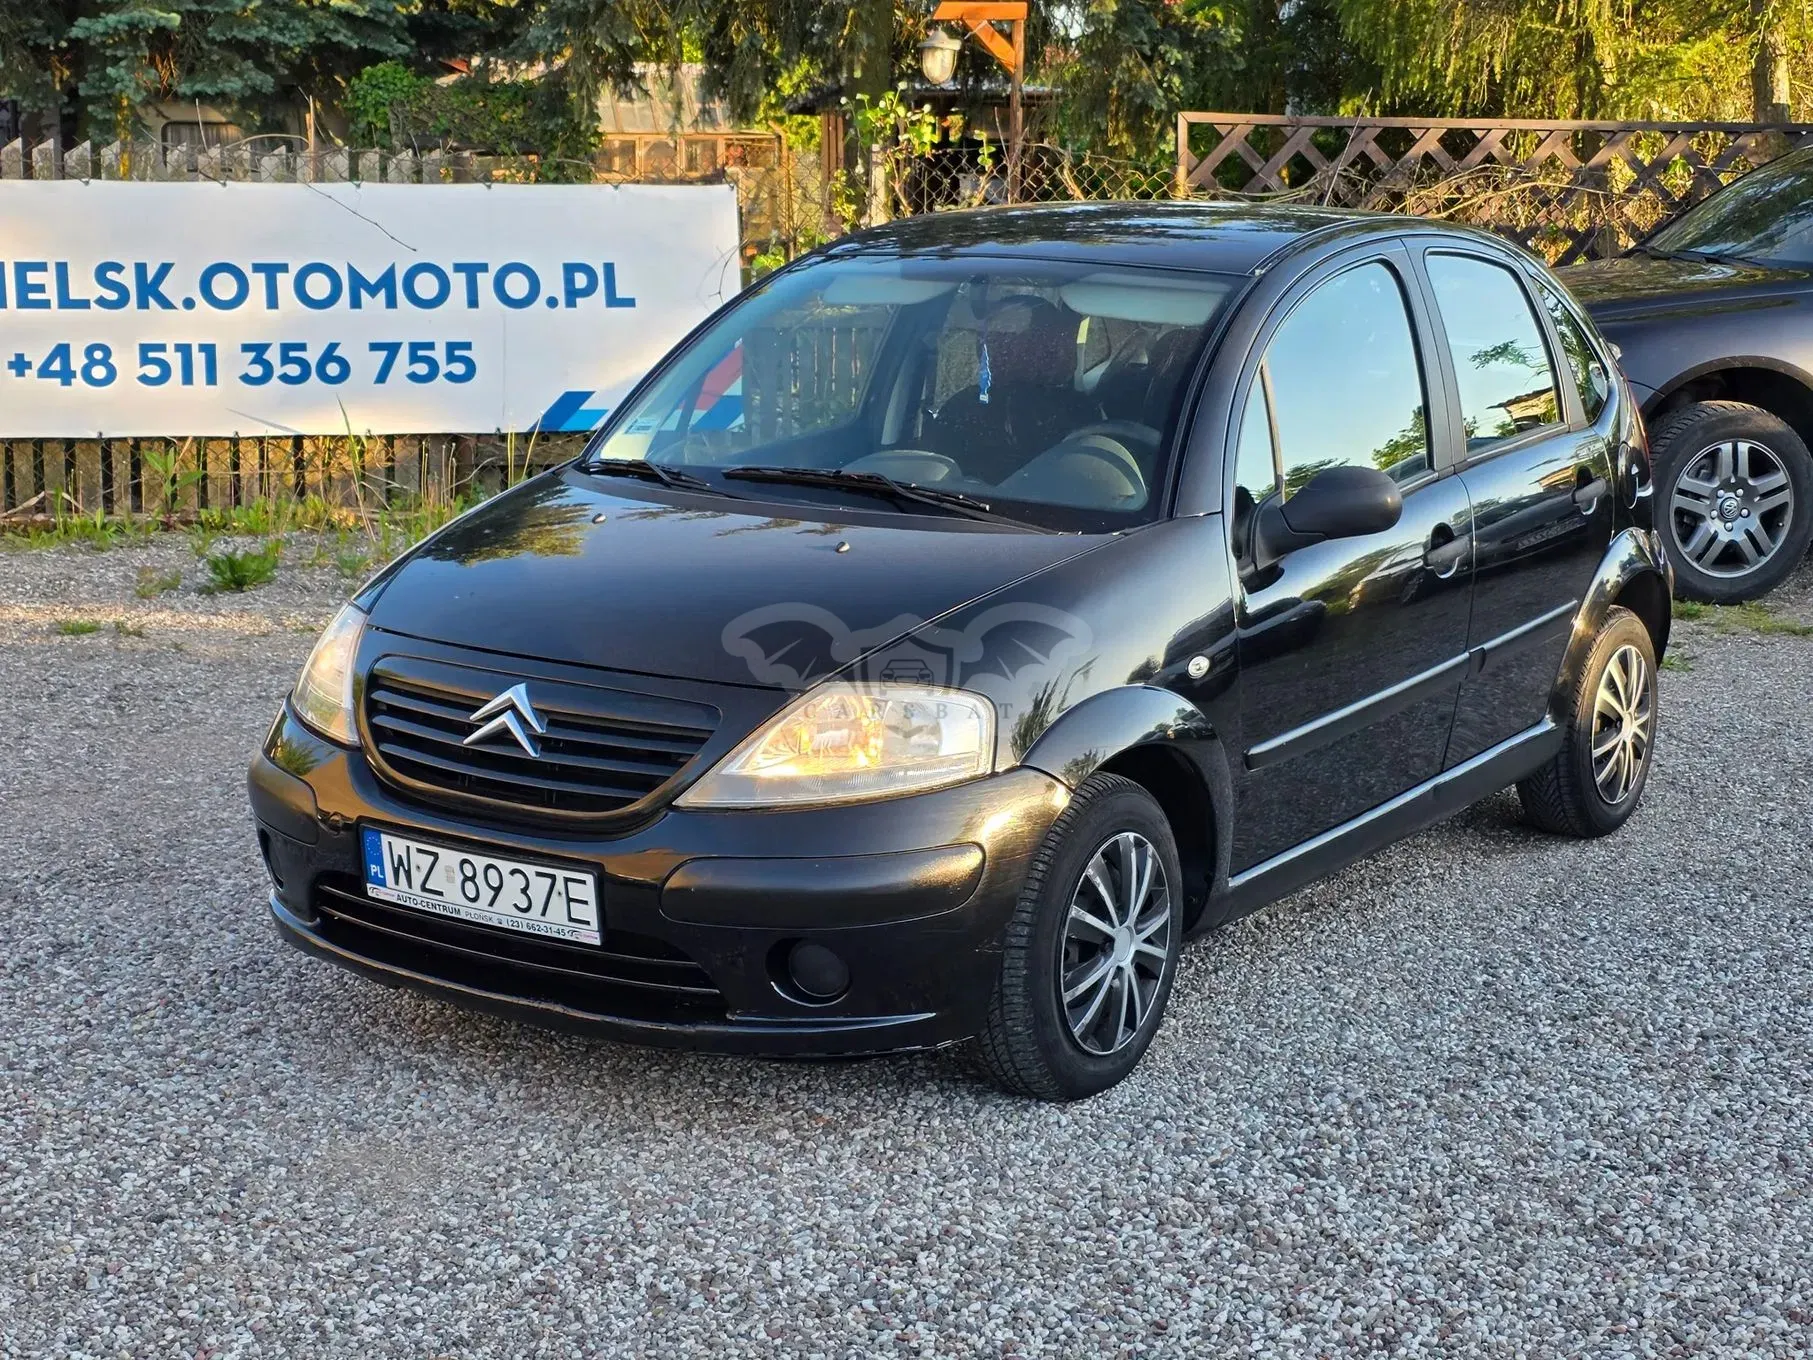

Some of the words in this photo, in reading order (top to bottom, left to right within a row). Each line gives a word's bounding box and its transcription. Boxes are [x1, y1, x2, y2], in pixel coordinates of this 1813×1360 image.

[8, 343, 117, 387] +48
[137, 342, 217, 386] 511
[238, 341, 351, 385] 356
[367, 340, 477, 385] 755
[370, 864, 385, 879] PL
[387, 840, 445, 897] WZ
[459, 858, 591, 927] 8937E
[396, 893, 462, 916] AUTO-CENTRUM
[506, 918, 524, 929] (23)
[526, 921, 567, 937] 662-31-45
